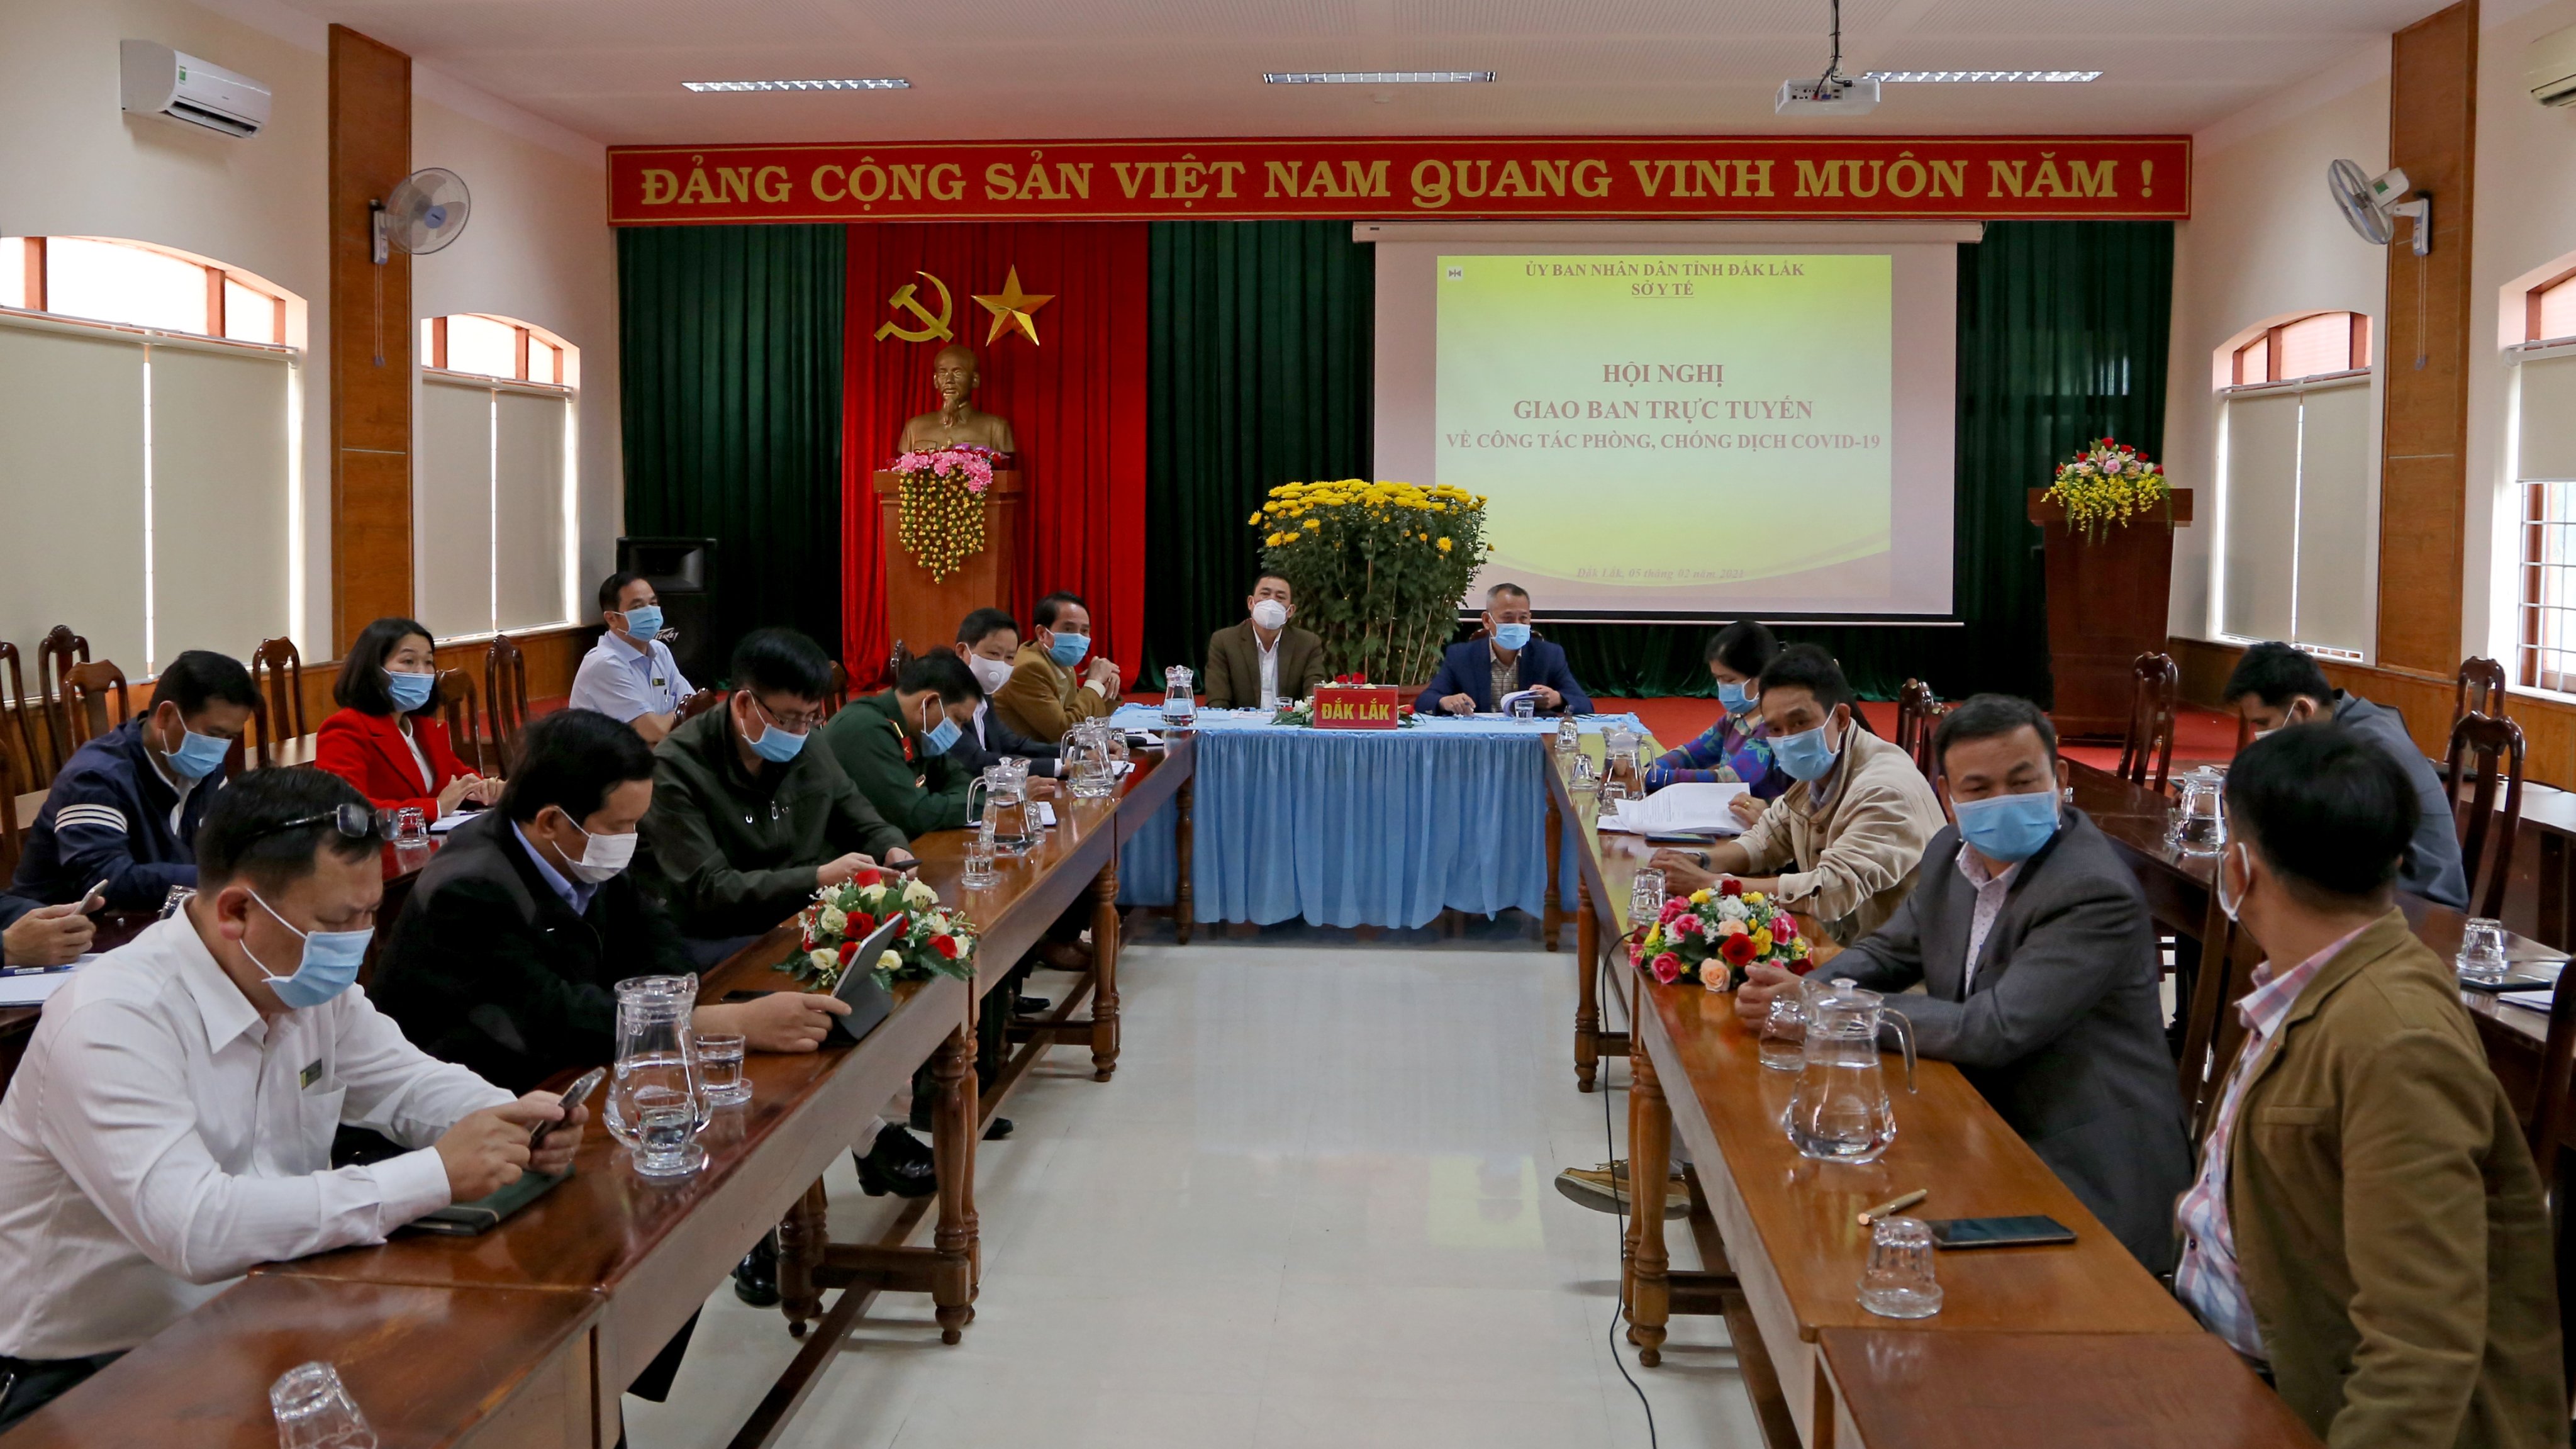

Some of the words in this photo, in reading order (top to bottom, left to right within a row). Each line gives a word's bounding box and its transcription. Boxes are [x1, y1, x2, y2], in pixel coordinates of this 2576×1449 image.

[640, 155, 792, 204] ĐẢNG
[811, 156, 966, 211] CỘNG
[985, 150, 1093, 200] SẢN
[1111, 154, 1246, 208] VIỆT
[1264, 160, 1391, 198] NAM
[1410, 160, 1612, 208] QUANG
[1630, 160, 1775, 197] VINH
[1794, 151, 1968, 198] MUÔN
[1988, 152, 2118, 198] NĂM
[2141, 160, 2153, 198] !
[1525, 260, 1549, 276] ỦY
[1553, 264, 1586, 276] BAN
[1591, 260, 1639, 276] NHÂN
[1644, 260, 1678, 276] DÂN
[1682, 260, 1723, 276] TỈNH
[1632, 280, 1654, 296] SỞ
[1657, 283, 1668, 296] Y
[1671, 279, 1694, 296] TẾ
[1602, 361, 1650, 388] HỘI
[1657, 364, 1724, 388] NGHỊ
[1514, 400, 1580, 419] GIAO
[1587, 401, 1640, 419] BAN
[1646, 398, 1719, 424] TRỰC
[1725, 395, 1813, 419] TUYẾN
[1476, 430, 1533, 448] CÔNG
[1537, 430, 1577, 448] TÁC
[1582, 430, 1656, 450] PHÒNG,
[1661, 430, 1732, 449] CHỐNG
[1737, 434, 1787, 452] DỊCH
[1792, 434, 1880, 449] COVID-19
[1322, 698, 1354, 720] ĐẮK
[1359, 698, 1390, 720] LẮK
